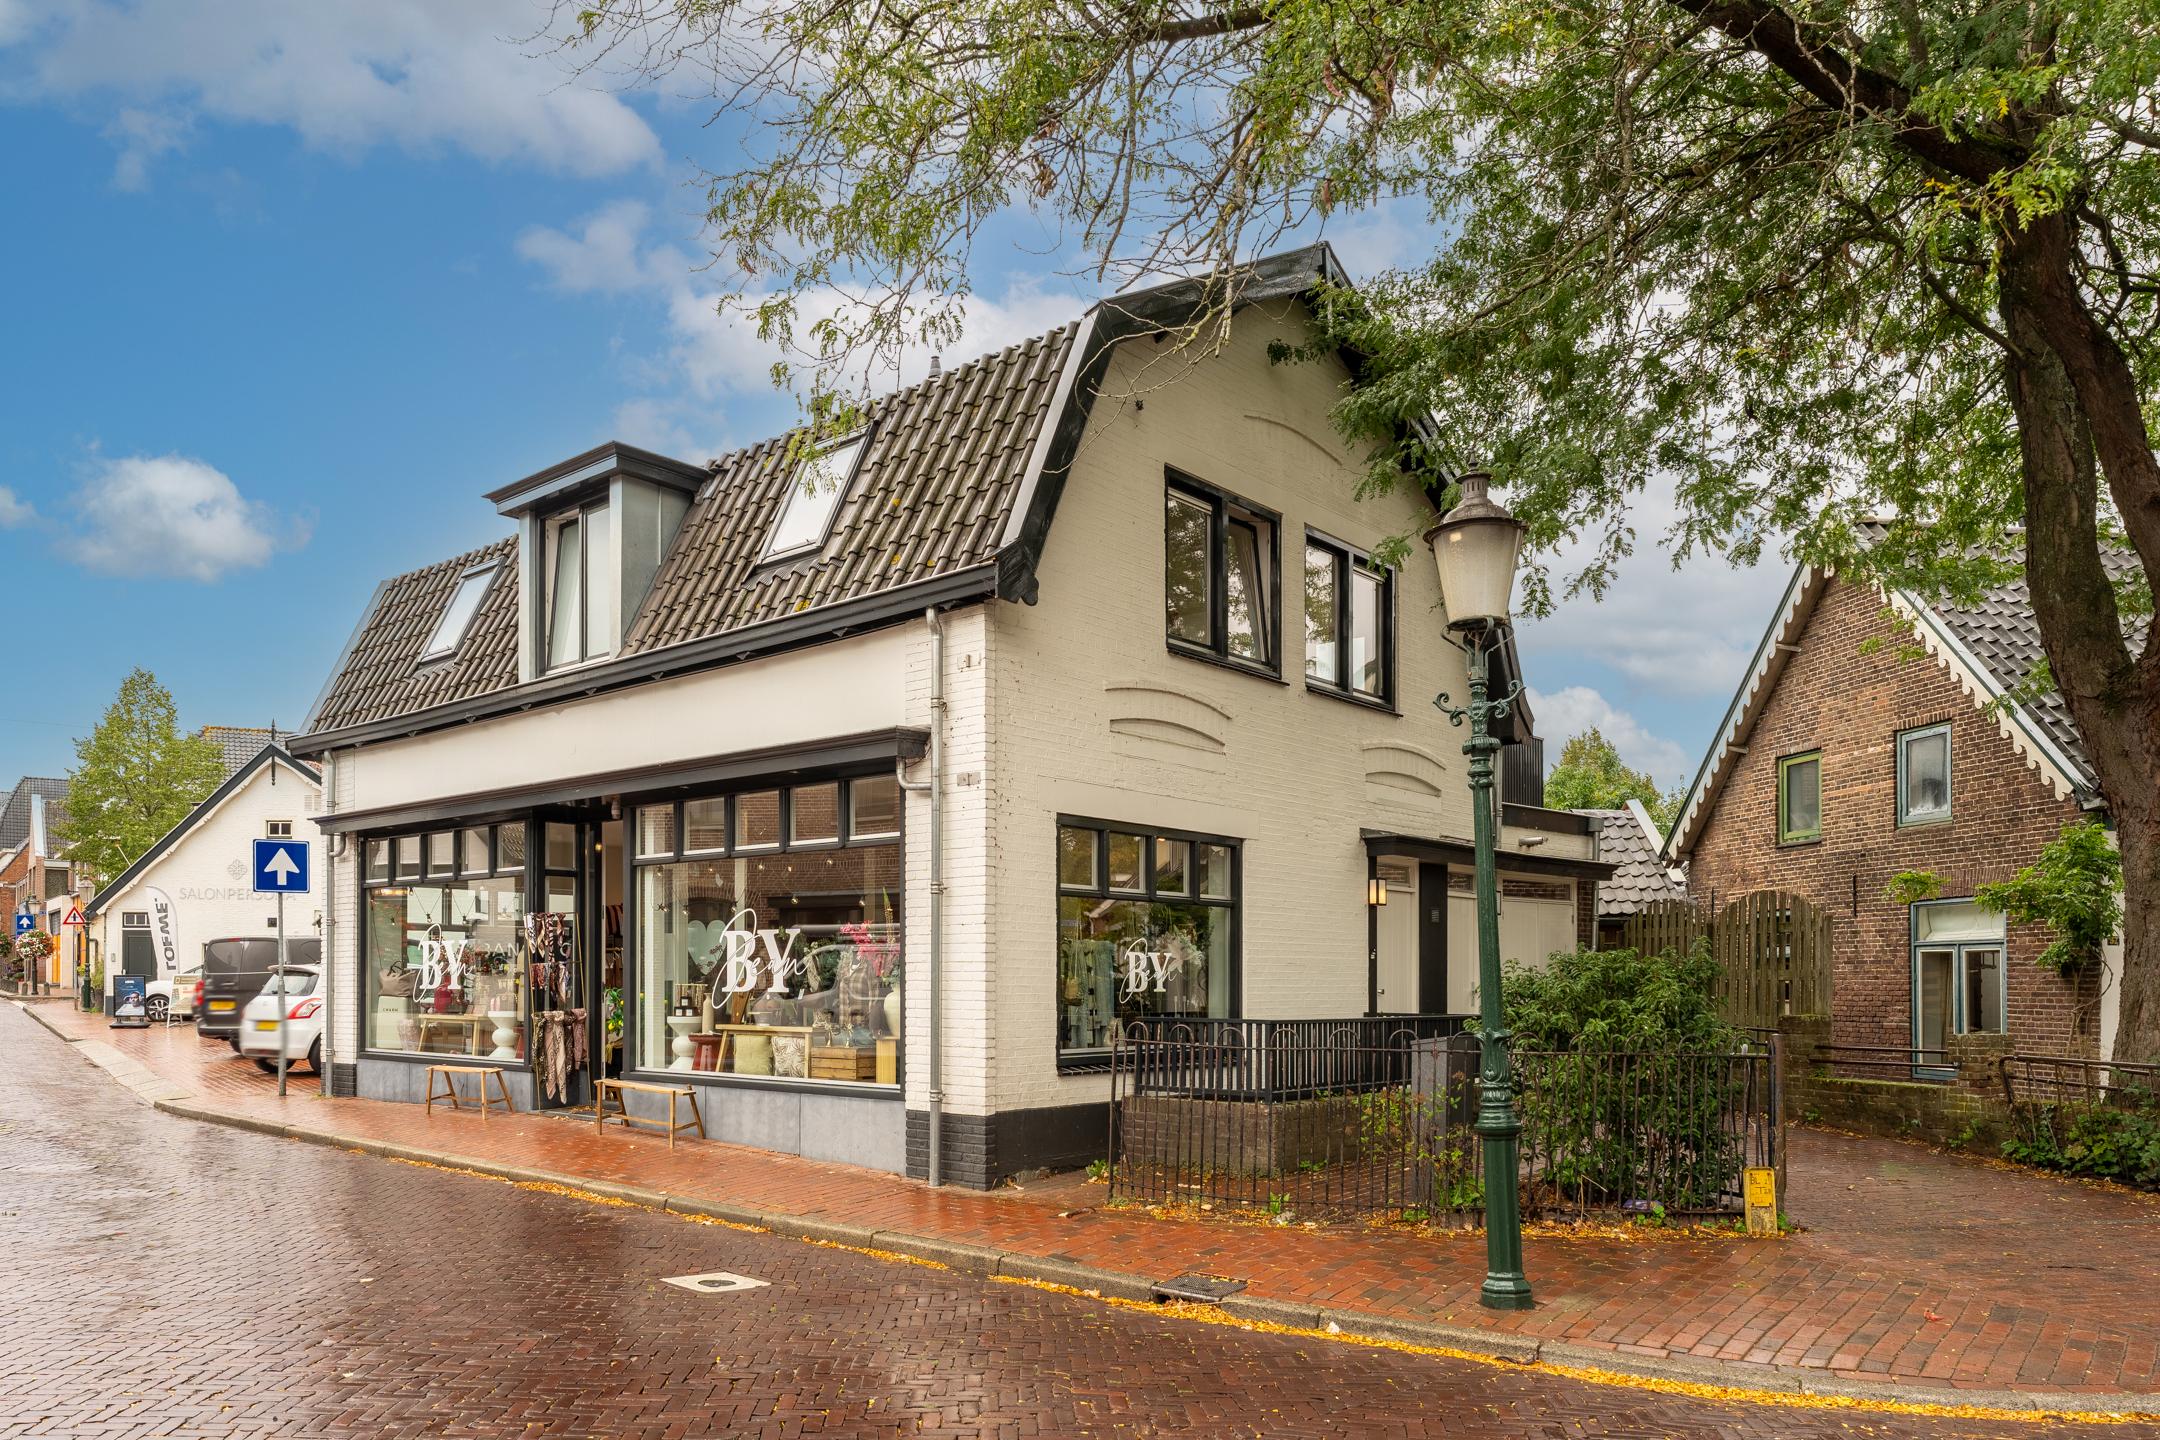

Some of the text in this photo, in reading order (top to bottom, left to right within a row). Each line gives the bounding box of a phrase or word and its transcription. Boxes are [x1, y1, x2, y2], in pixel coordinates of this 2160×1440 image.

[420, 940, 468, 989] BY
[722, 929, 800, 992] BY
[1126, 951, 1172, 992] BY
